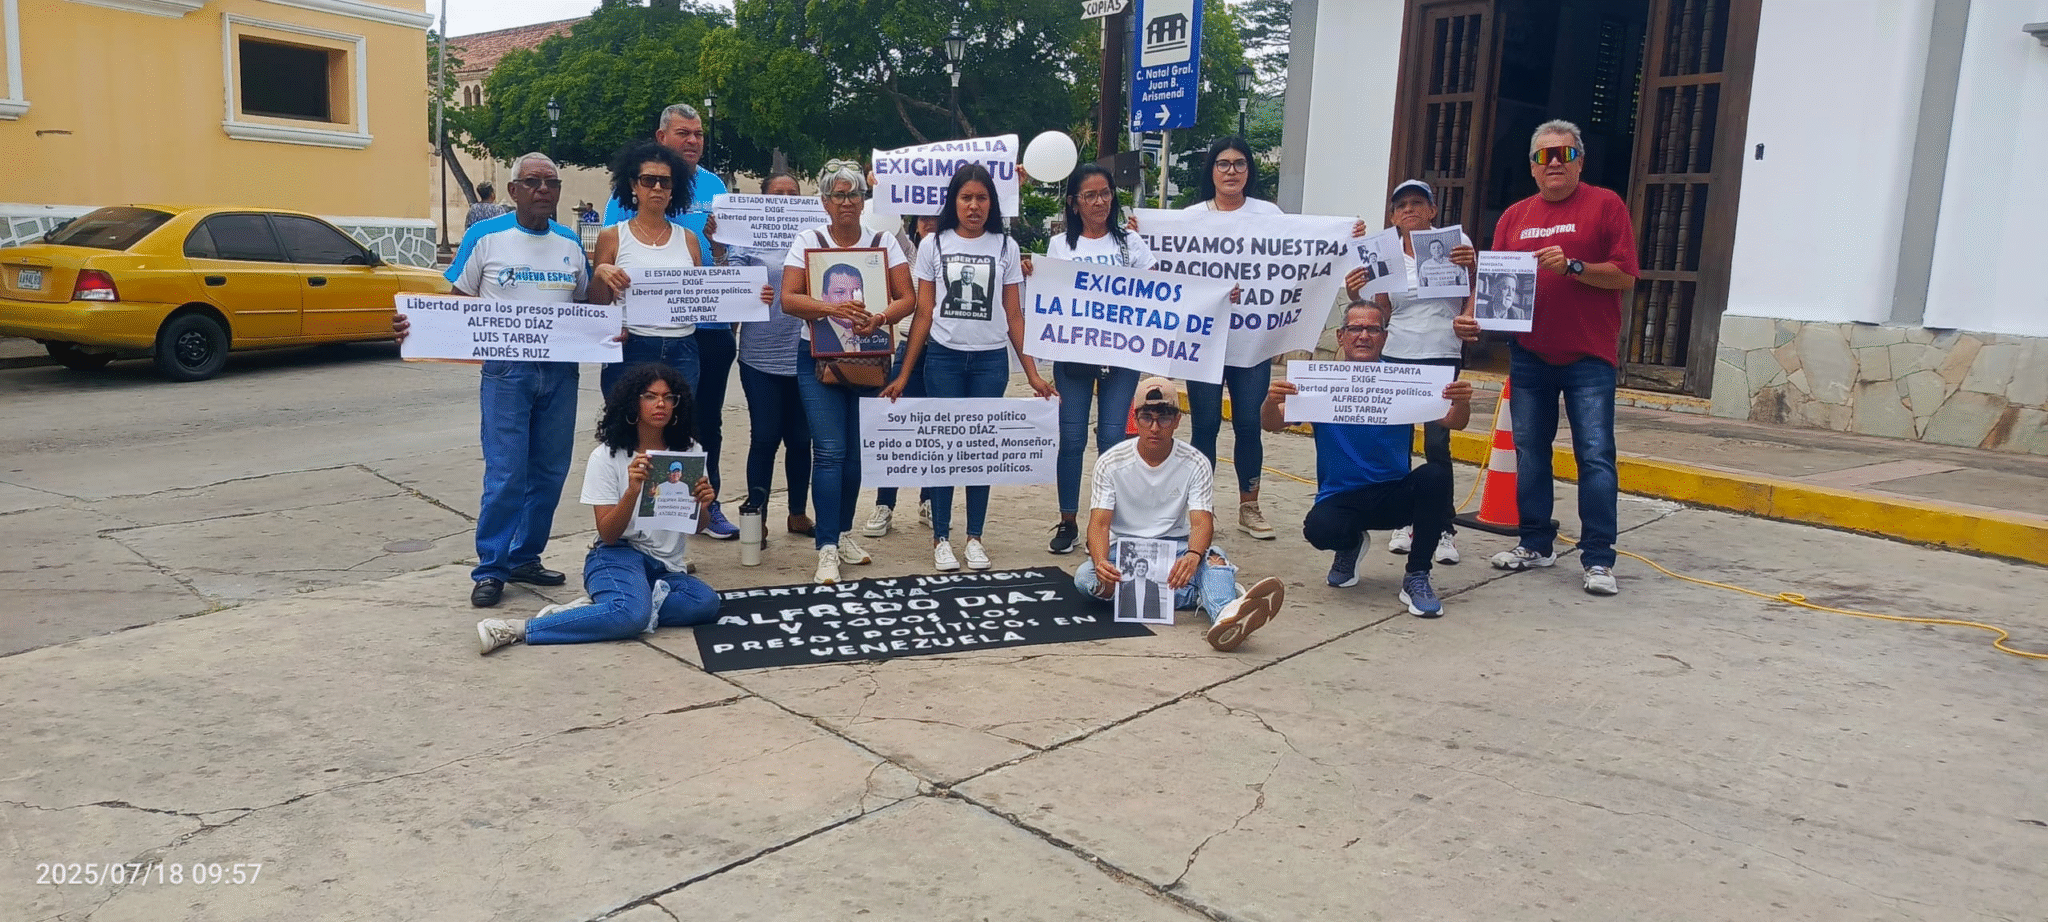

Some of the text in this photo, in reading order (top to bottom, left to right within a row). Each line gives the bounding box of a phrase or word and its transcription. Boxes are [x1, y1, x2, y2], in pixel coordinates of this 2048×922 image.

[1086, 0, 1121, 15] COPIAS
[1136, 63, 1194, 80] C. Natal Gral.
[1148, 77, 1179, 91] Juan B.
[1142, 88, 1184, 102] Arismendi
[986, 160, 1014, 180] TU
[738, 196, 764, 204] ESTADO
[789, 198, 820, 206] ESPARTA
[764, 206, 785, 214] EXIGE
[718, 213, 747, 222] Libertad
[765, 214, 778, 222] los
[782, 222, 798, 231] DÍAZ
[1540, 224, 1576, 237] CONTROL
[770, 232, 796, 240] TARBAY
[1250, 237, 1348, 257] NUESTRAS
[946, 256, 991, 264] LIBERTAD
[516, 272, 545, 282] NUEVA
[654, 269, 682, 277] ESTADO
[683, 269, 707, 277] NUEVA
[682, 278, 704, 286] EXIGE
[1074, 271, 1182, 302] EXIGIMOS
[632, 288, 663, 296] Libertad
[664, 289, 682, 298] para
[695, 289, 720, 297] presos
[667, 295, 719, 304] ALFREDO DÍAZ
[1280, 288, 1303, 306] DE
[407, 298, 608, 319] Libertad para los presos políticos.
[670, 306, 686, 314] LUIS
[1035, 294, 1063, 316] LA
[1071, 298, 1180, 330] LIBERTAD
[1186, 314, 1214, 336] DE
[467, 317, 553, 330] ALFREDO DÍAZ
[670, 314, 718, 323] ANDRÉS RUIZ
[1267, 308, 1302, 331] DIAZ
[472, 332, 549, 344] LUIS TARBAY
[1040, 324, 1201, 362] ALFREDO DIAZ
[472, 345, 550, 359] ANDRÉS RUIZ
[1308, 364, 1421, 375] El ESTADO NUEVA ESPARTA
[1351, 375, 1376, 383] EXIGE
[1298, 384, 1434, 398] ibertad para los presos políticos.
[1332, 395, 1392, 404] ALFREDO DÍAZ
[1354, 406, 1388, 414] TARBAY
[888, 411, 1026, 424] Soy hija del preso político
[1332, 414, 1388, 424] ANDRÉS RUIZ
[917, 423, 998, 435] ALFREDO DÍAZ.
[864, 437, 1056, 450] Le pido a DIOS, y a usted, Monseñor,
[876, 449, 1042, 462] su bendición y libertad para mi
[886, 463, 1033, 475] padre y los presos políticos.
[718, 582, 860, 600] IBERTAD
[916, 571, 1045, 586] JUSTICIA
[717, 590, 1063, 626] ALFREDO DIAZ
[823, 612, 941, 628] TODOS
[960, 608, 1020, 618] LOS
[713, 615, 1096, 654] PRESOS POLÍTICOS EN
